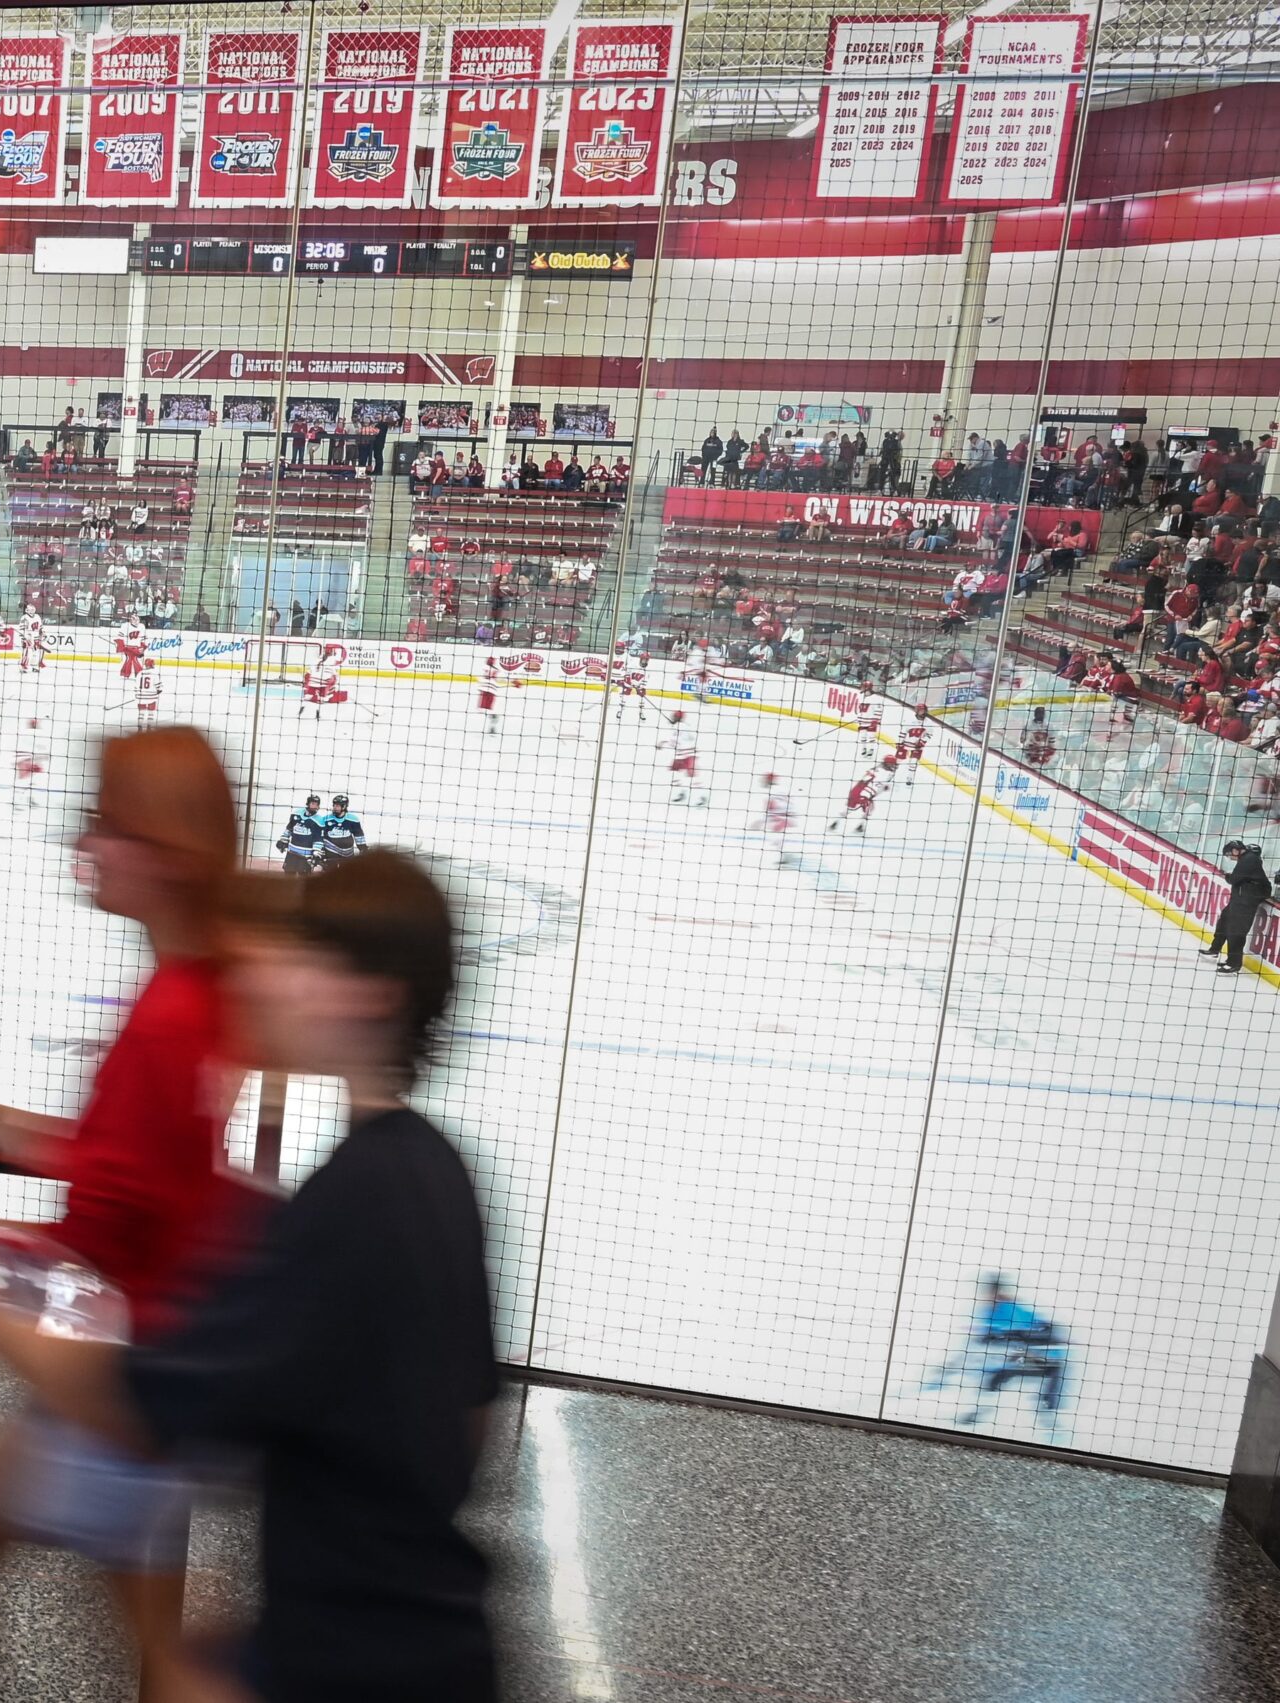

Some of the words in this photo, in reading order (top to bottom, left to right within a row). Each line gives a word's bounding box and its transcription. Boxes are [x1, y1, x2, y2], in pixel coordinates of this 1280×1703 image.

[584, 44, 659, 58] NATIONAL
[846, 42, 890, 53] FROZEN
[894, 42, 924, 53] FOUR
[1007, 42, 1037, 52] NCAA
[220, 52, 287, 65] NATIONAL
[338, 50, 407, 63] NATIONAL
[461, 47, 533, 61] NATIONAL
[842, 54, 924, 65] APPEARANCES
[979, 54, 1063, 64] TOURNAMENTS
[102, 54, 168, 67] NATIONAL
[583, 59, 659, 73] CHAMPIONS
[101, 67, 169, 80] CHAMPIONS
[218, 66, 287, 79] CHAMPIONS
[336, 64, 406, 78] CHAMPIONS
[460, 61, 532, 75] CHAMPIONS
[333, 88, 404, 114] 2019
[459, 81, 529, 112] 2021
[579, 79, 655, 111] 2023
[837, 91, 860, 101] 2009
[867, 91, 890, 100] 2011
[896, 90, 920, 100] 2012
[973, 91, 996, 101] 2008
[1003, 91, 1026, 100] 2009
[1033, 91, 1056, 100] 2011
[99, 90, 166, 116] 2009
[218, 91, 280, 114] 2011
[835, 108, 857, 118] 2014
[865, 108, 888, 118] 2015
[895, 107, 918, 117] 2016
[970, 108, 993, 118] 2012
[1001, 108, 1023, 118] 2014
[1031, 108, 1054, 118] 2015
[833, 125, 855, 134] 2017
[863, 124, 885, 134] 2018
[892, 124, 916, 134] 2019
[967, 125, 991, 135] 2016
[998, 125, 1022, 134] 2017
[1028, 125, 1051, 135] 2018
[106, 141, 158, 153] FROZEN
[222, 140, 277, 153] FROZEN
[831, 142, 852, 151] 2021
[861, 141, 884, 150] 2023
[890, 141, 914, 150] 2024
[965, 142, 988, 151] 2019
[996, 142, 1019, 151] 2020
[1026, 142, 1047, 151] 2021
[334, 151, 367, 160] FROZEN
[368, 151, 391, 160] FOUR
[459, 148, 492, 159] FROZEN
[493, 149, 516, 159] FOUR
[582, 149, 617, 159] FROZEN
[618, 148, 641, 158] FOUR
[108, 153, 155, 168] FOUR
[830, 158, 851, 168] 2025
[963, 159, 987, 168] 2022
[995, 158, 1018, 167] 2023
[1024, 158, 1046, 167] 2024
[960, 175, 983, 185] 2025
[174, 244, 182, 255] 0
[254, 244, 292, 254] WISCONSI
[305, 243, 345, 258] 32:06
[364, 245, 388, 255] MAINE
[496, 247, 505, 258] 0
[169, 259, 174, 269] 1
[272, 257, 283, 272] 0
[373, 258, 385, 273] 0
[549, 252, 572, 268] Old
[573, 252, 611, 269] Dutch
[492, 263, 496, 272] 1
[230, 353, 244, 378] 8
[245, 359, 304, 373] NATIOAL
[308, 360, 405, 375] CHAMPIONSHIPS
[850, 498, 981, 533] WISCONSIN!
[195, 638, 246, 659] Culver's
[349, 651, 375, 659] credit
[140, 677, 150, 689] 16
[725, 682, 753, 692] FAMILY
[1158, 853, 1232, 927] WISCONS
